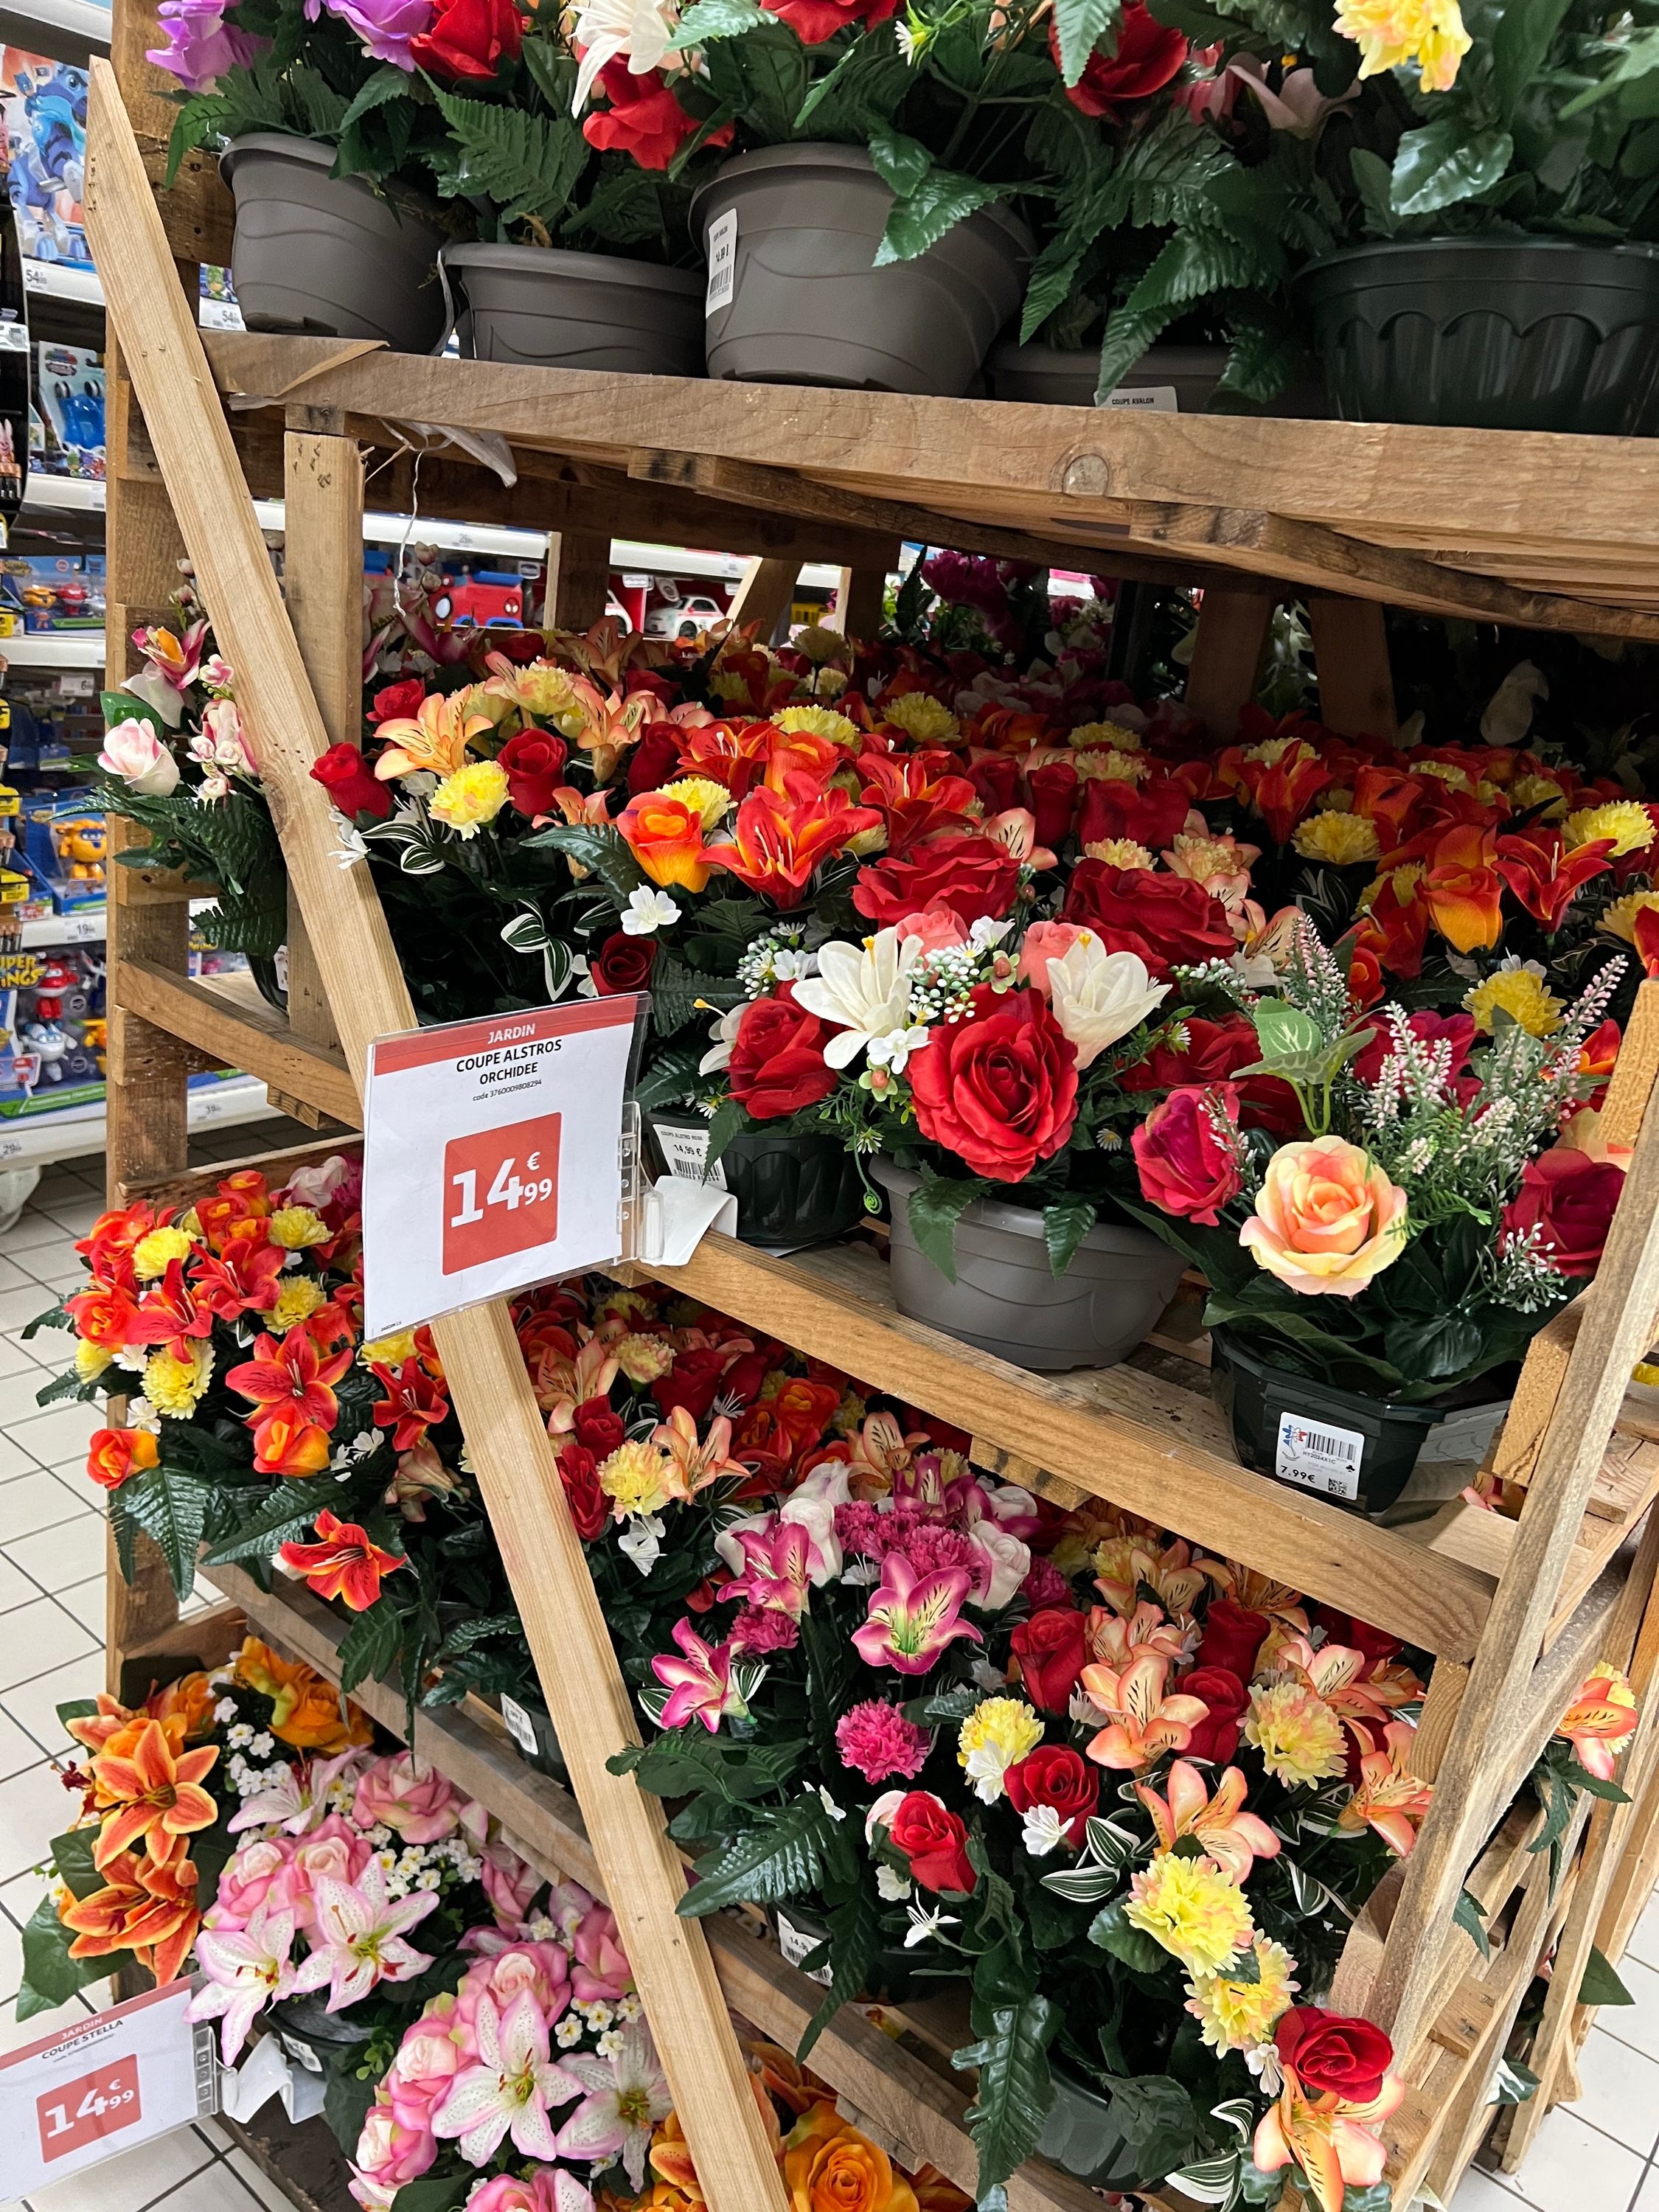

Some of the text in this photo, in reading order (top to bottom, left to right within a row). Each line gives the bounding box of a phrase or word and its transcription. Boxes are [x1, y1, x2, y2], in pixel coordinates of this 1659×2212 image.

[0, 967, 48, 989] INGS
[487, 1023, 536, 1044] JARDIN
[456, 1040, 562, 1073] COUPE ALSTROS
[479, 1062, 538, 1085] ORCHIDEE
[473, 1092, 488, 1102] code
[1281, 1465, 1315, 1484] 7.99€
[42, 2038, 80, 2059] COUPE
[82, 2020, 124, 2042] STELLA
[61, 2017, 103, 2040] JARDIN
